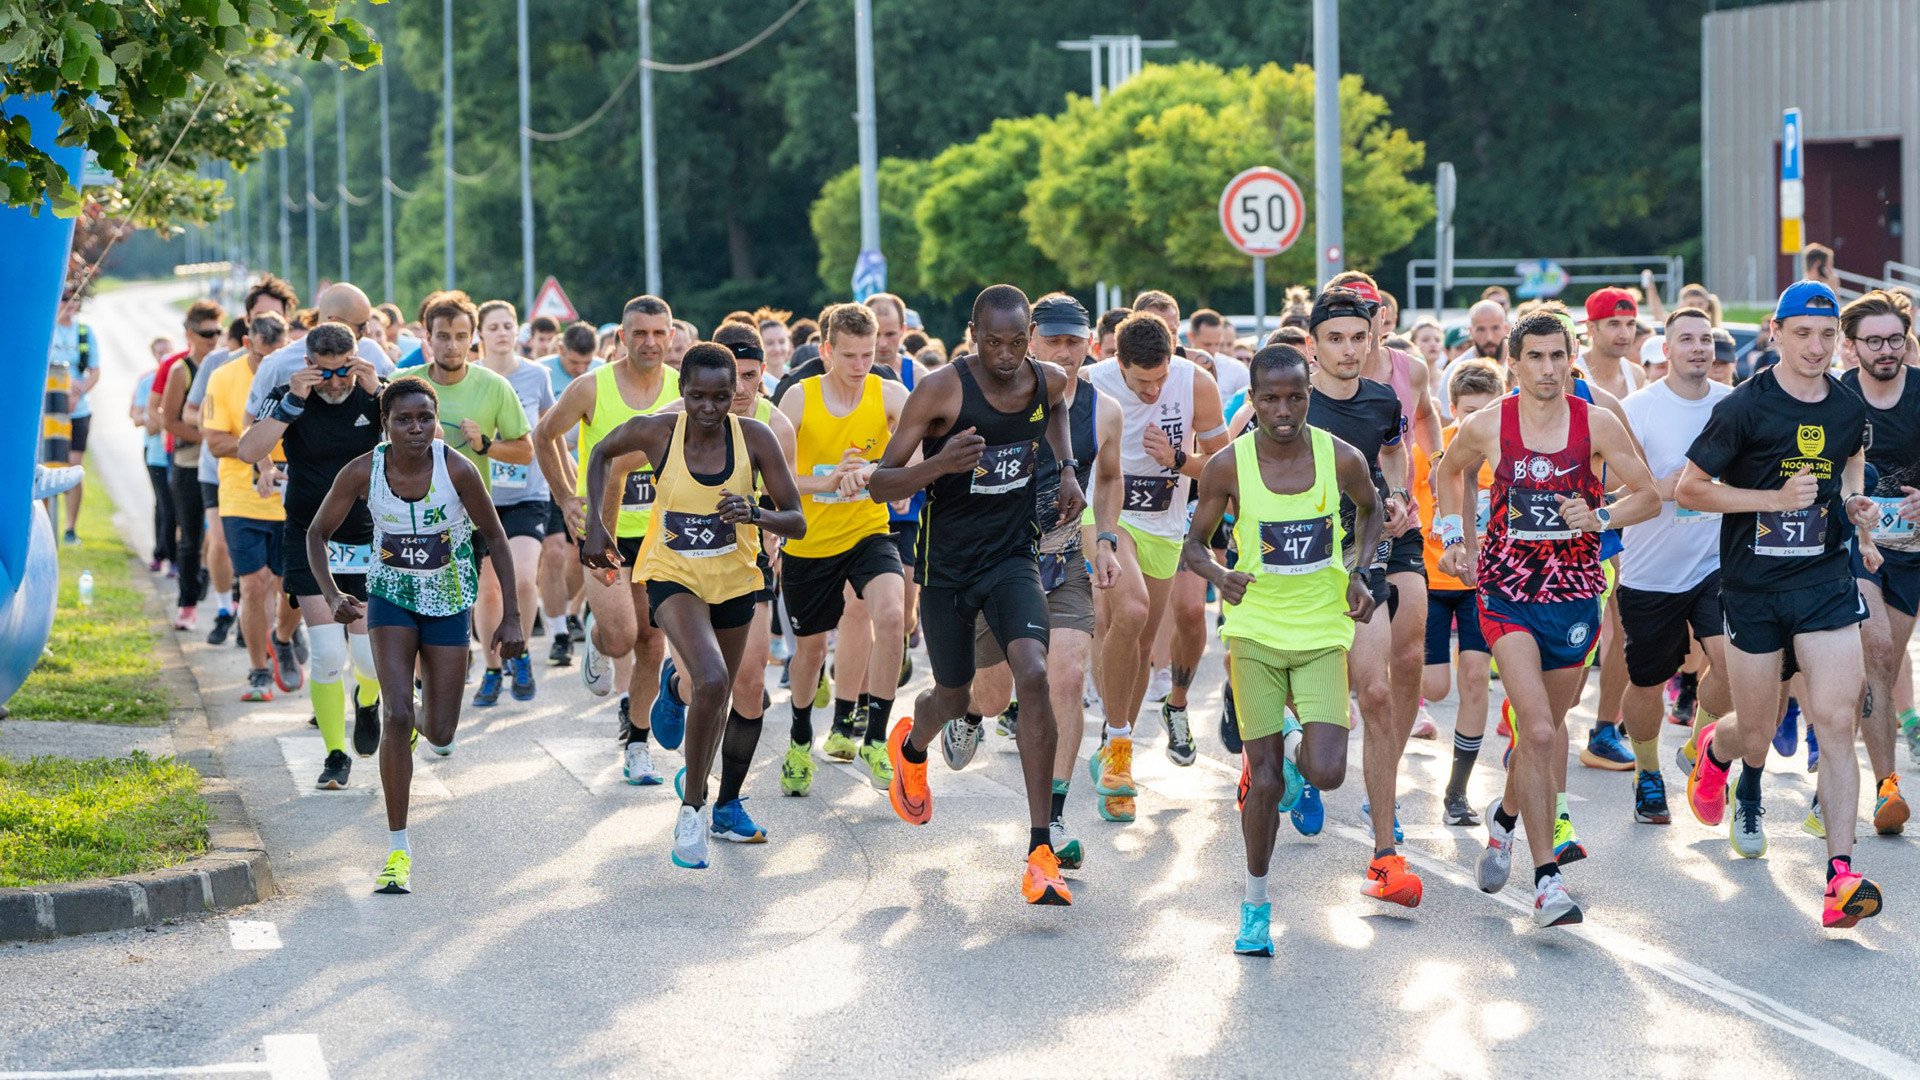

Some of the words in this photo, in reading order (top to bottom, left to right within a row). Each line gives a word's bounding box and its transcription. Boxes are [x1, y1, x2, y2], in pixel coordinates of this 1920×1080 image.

[1242, 194, 1285, 233] 50
[493, 463, 517, 477] 138
[994, 458, 1022, 480] 48
[636, 483, 650, 501] 11
[1129, 489, 1153, 508] 32
[423, 504, 447, 526] 5K
[1530, 506, 1560, 526] 52
[684, 527, 715, 545] 50
[1782, 521, 1806, 542] 51
[328, 546, 356, 562] 215
[400, 547, 429, 565] 49
[1283, 536, 1313, 560] 47
